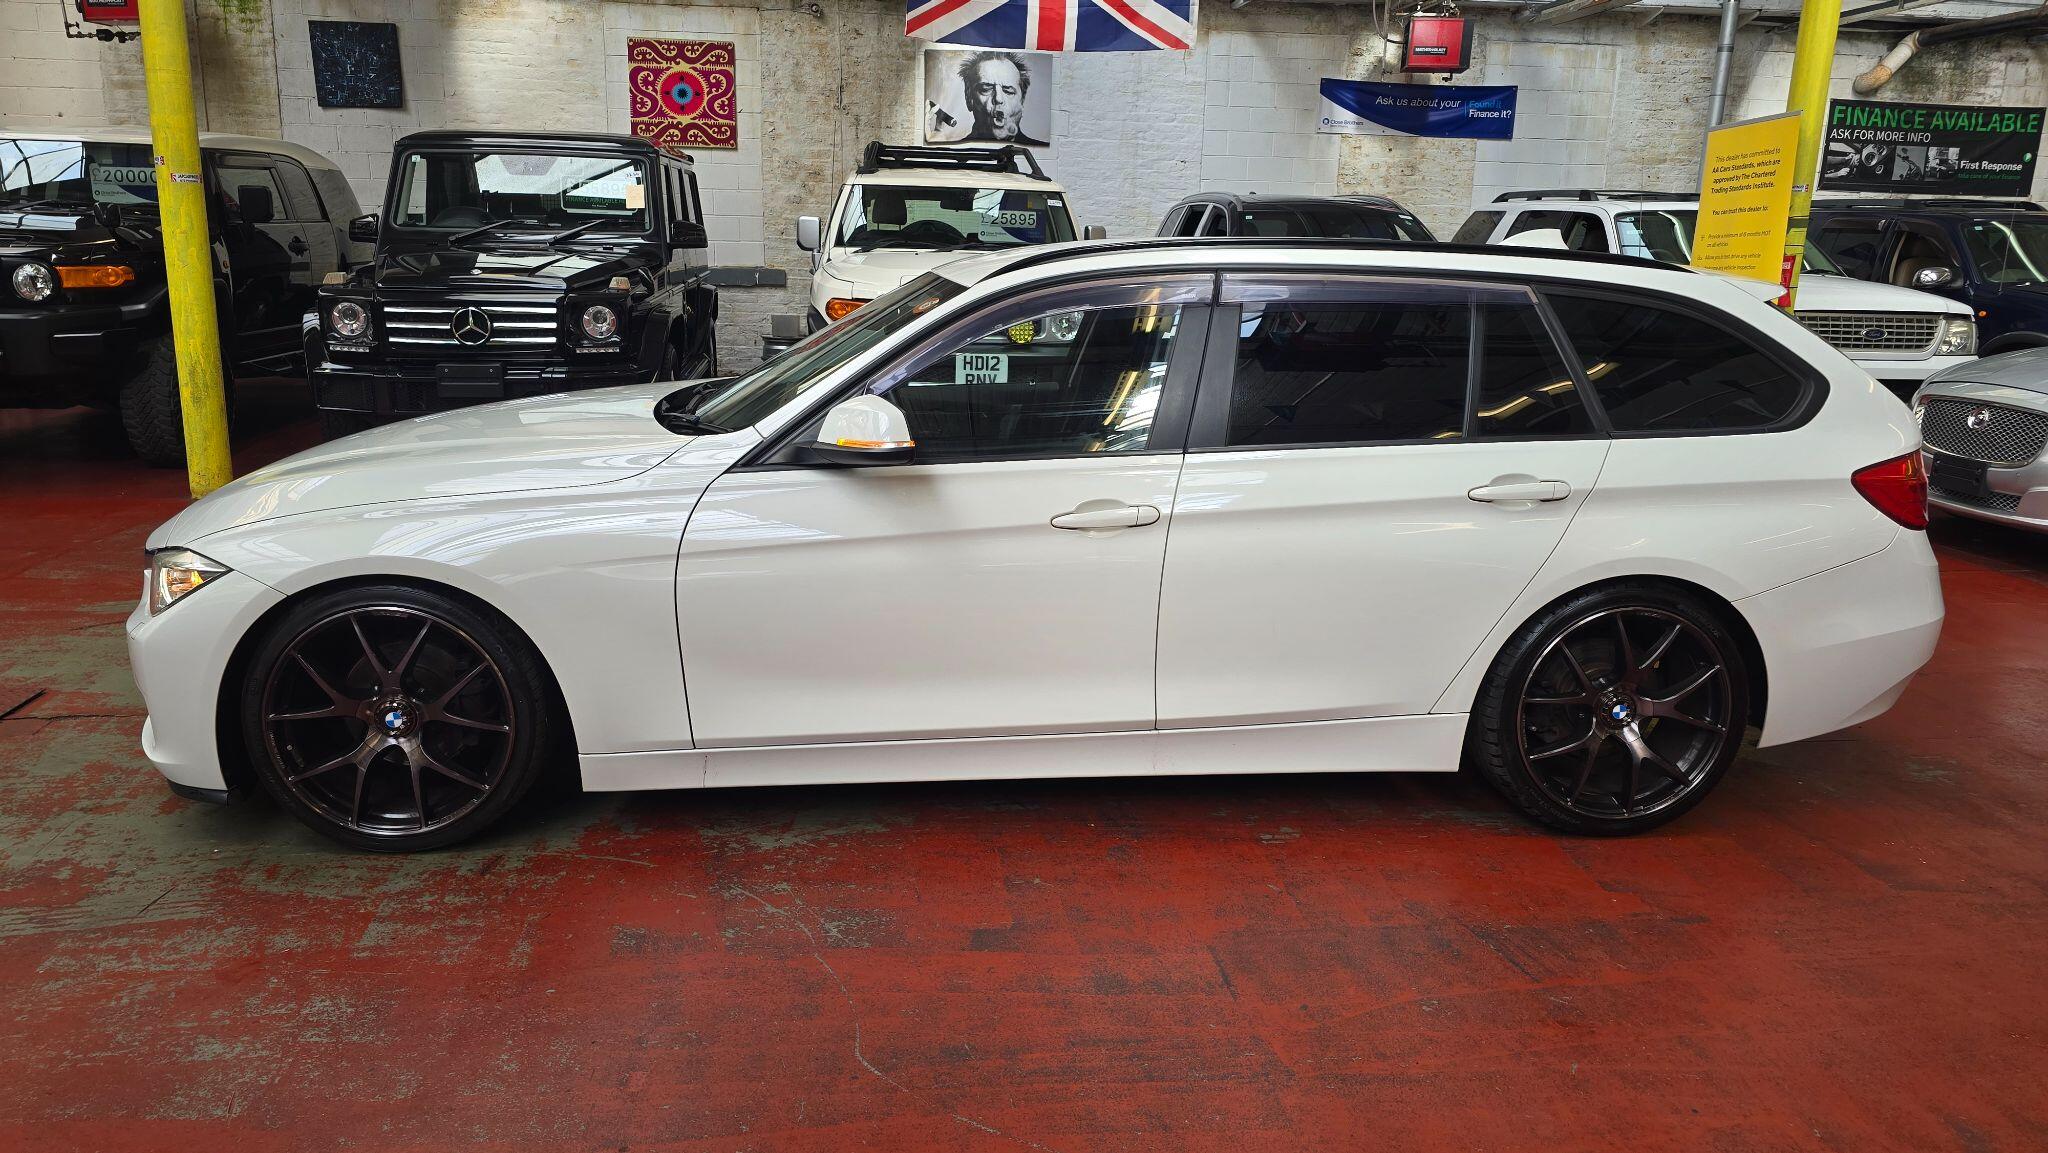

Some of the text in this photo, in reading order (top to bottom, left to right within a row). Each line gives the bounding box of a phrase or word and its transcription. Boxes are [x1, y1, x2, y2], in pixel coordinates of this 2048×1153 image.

[1375, 95, 1462, 110] Ask us about your
[1469, 100, 1495, 109] Found
[1468, 109, 1512, 119] Finance it?
[1832, 105, 2041, 133] FINANCE AVAILABLE
[1829, 128, 1931, 143] ASK FOR MORE INFO
[1960, 160, 2023, 172] First Response
[963, 355, 1001, 372] HD12
